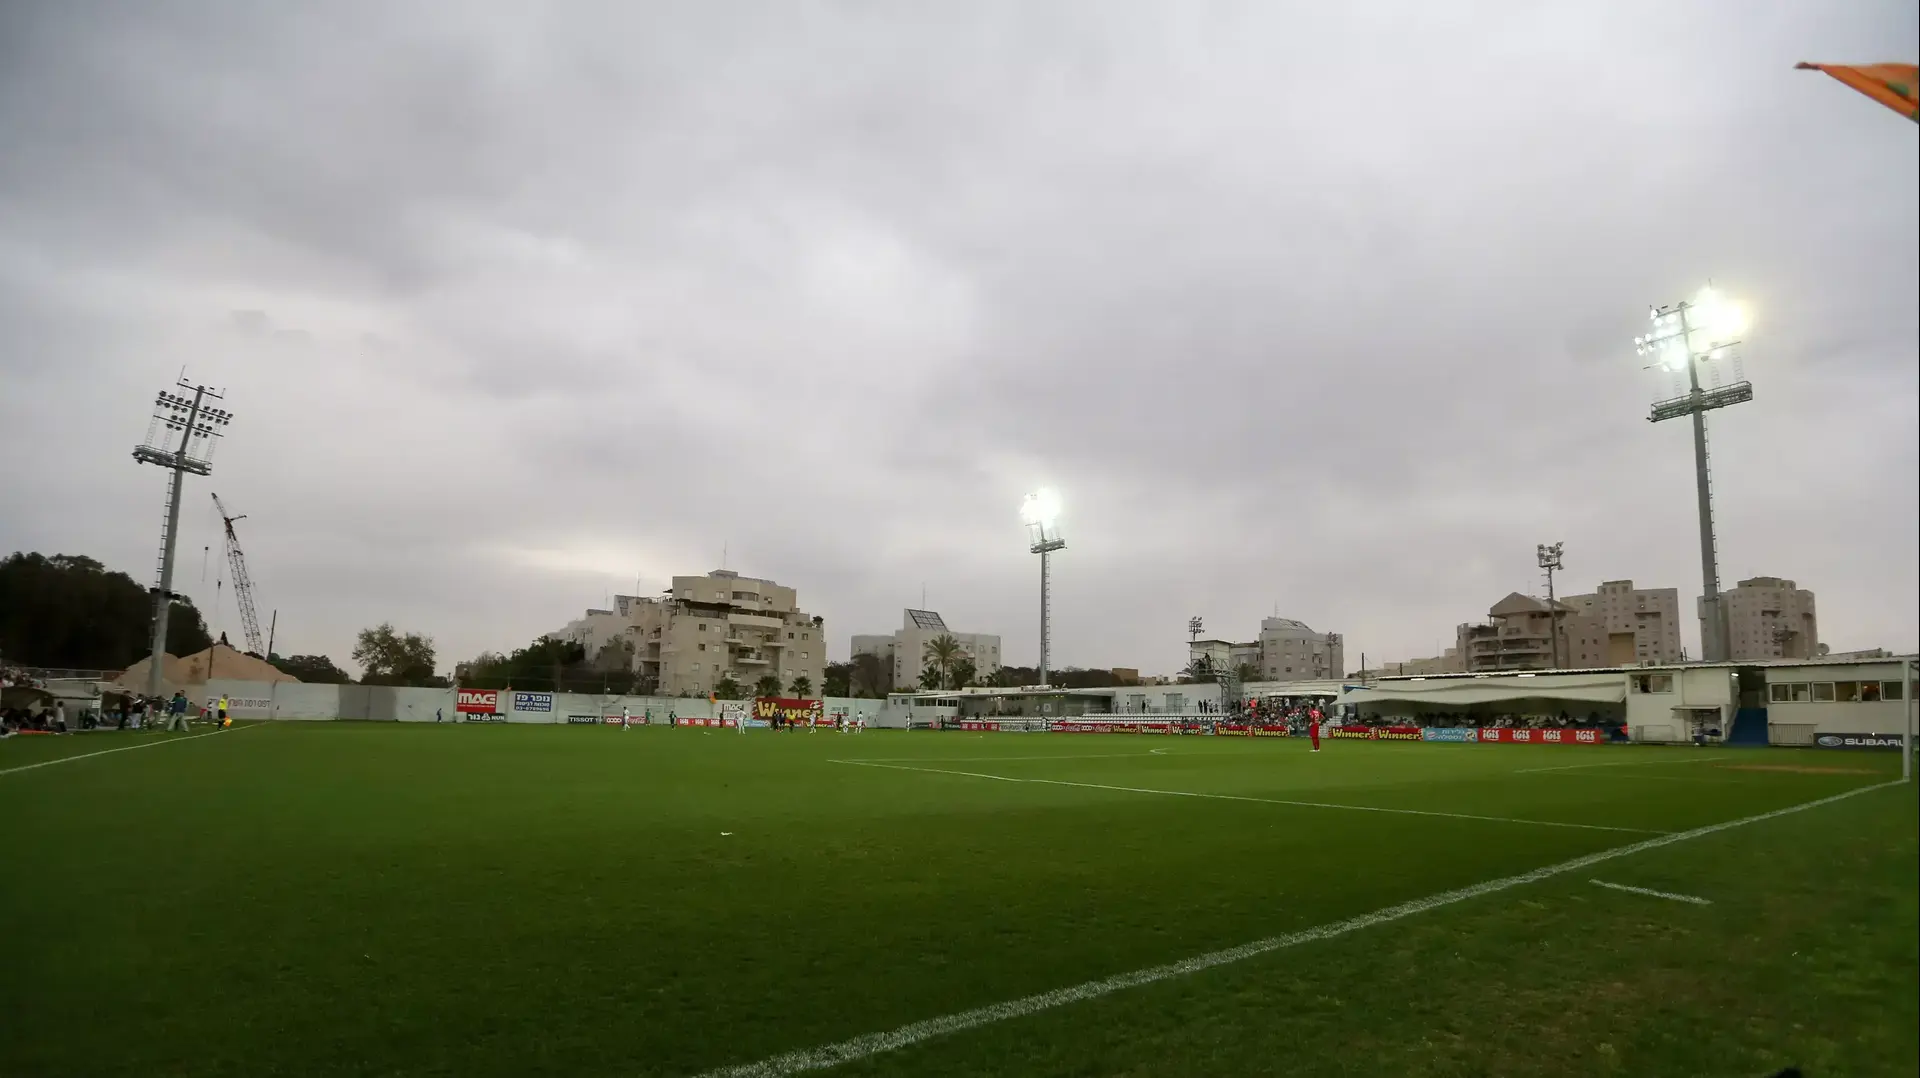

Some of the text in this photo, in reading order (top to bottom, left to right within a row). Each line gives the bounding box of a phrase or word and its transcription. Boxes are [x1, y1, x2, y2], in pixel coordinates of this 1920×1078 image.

[458, 693, 496, 704] MAG
[1113, 724, 1138, 733] Winner
[1141, 725, 1168, 734] Winner
[1172, 726, 1199, 735] Winer
[1218, 726, 1248, 736] Winner
[1254, 727, 1286, 737] Winner
[1332, 728, 1370, 738] Winner
[1378, 729, 1419, 740] Winner
